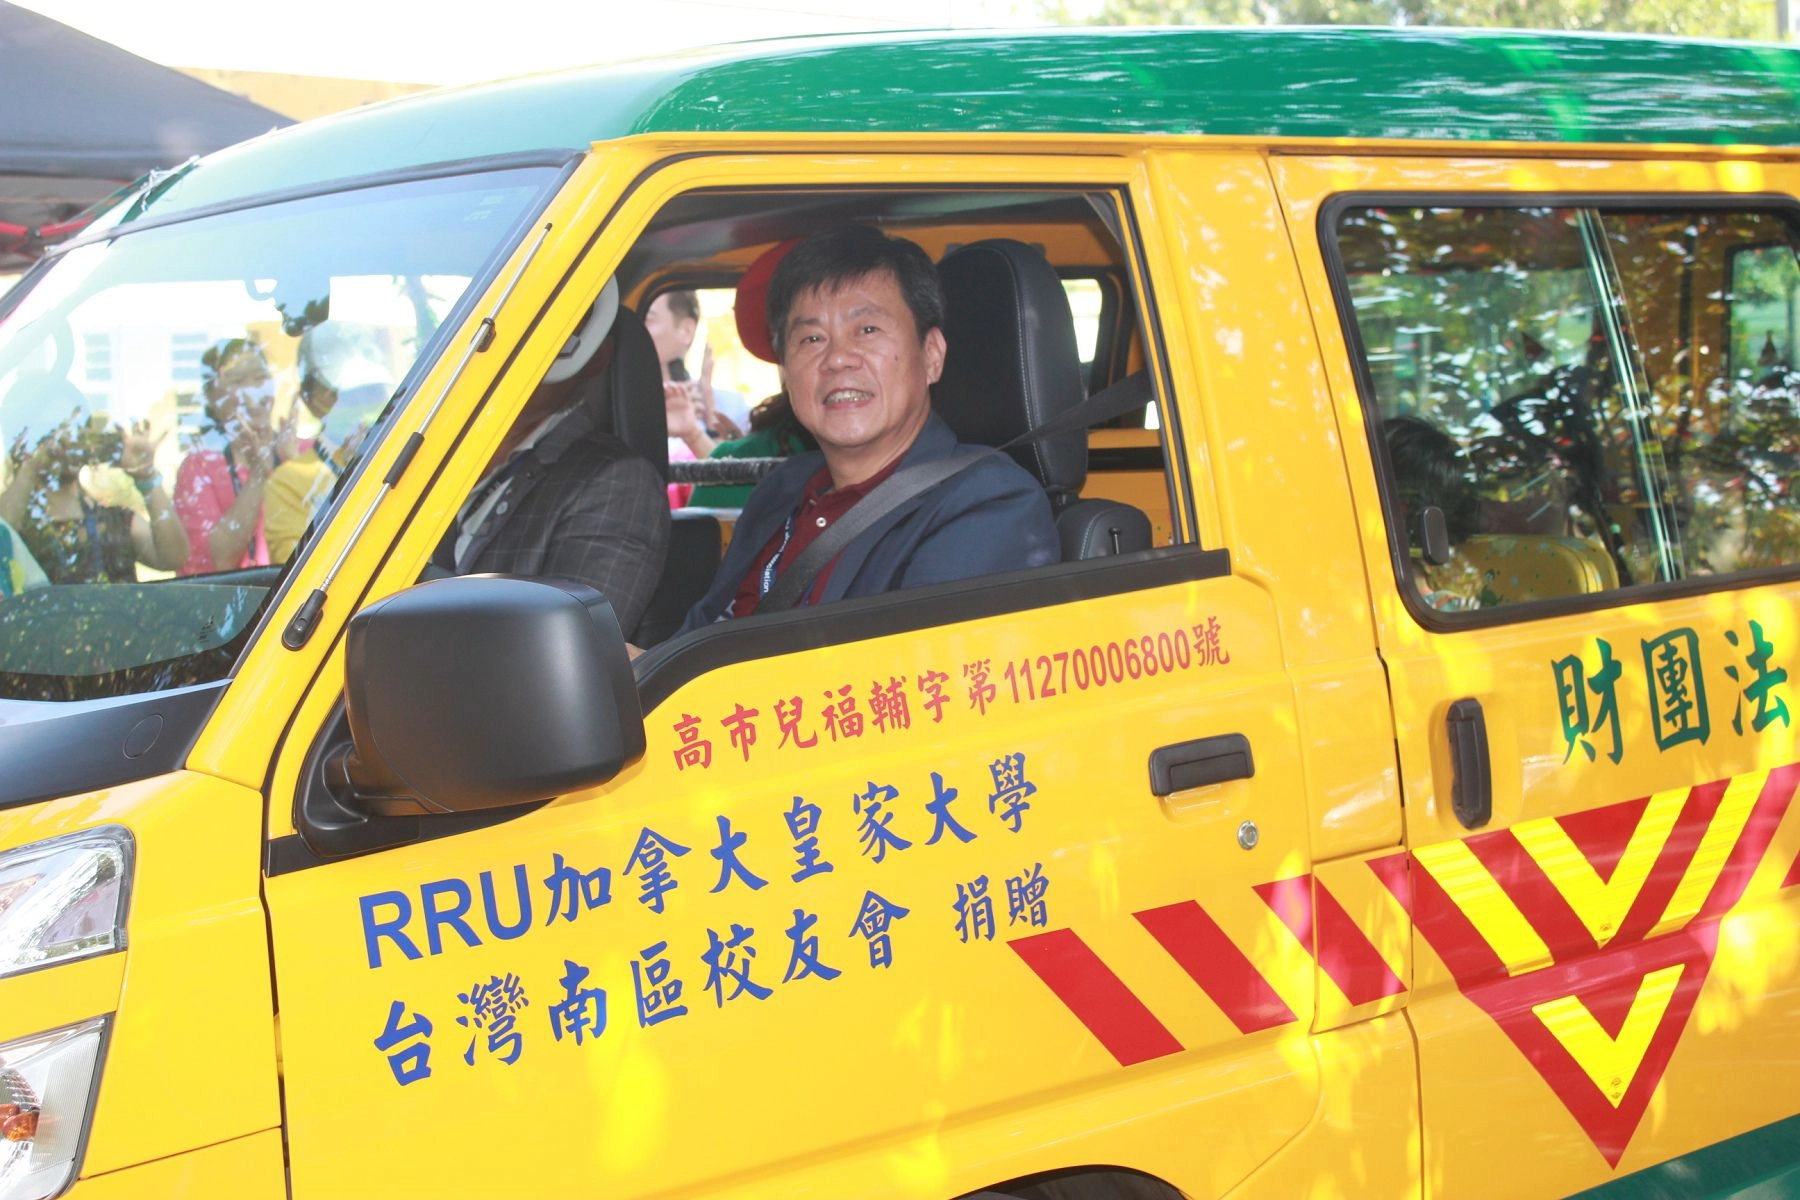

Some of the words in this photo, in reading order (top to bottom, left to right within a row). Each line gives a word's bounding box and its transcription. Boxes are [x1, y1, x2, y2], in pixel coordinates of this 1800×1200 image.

[672, 616, 1231, 770] 高市兒福輔字第11270006800號
[1551, 619, 1792, 765] 財團法
[374, 890, 910, 1086] 台灣南區校友會
[954, 863, 1050, 943] 捐贈
